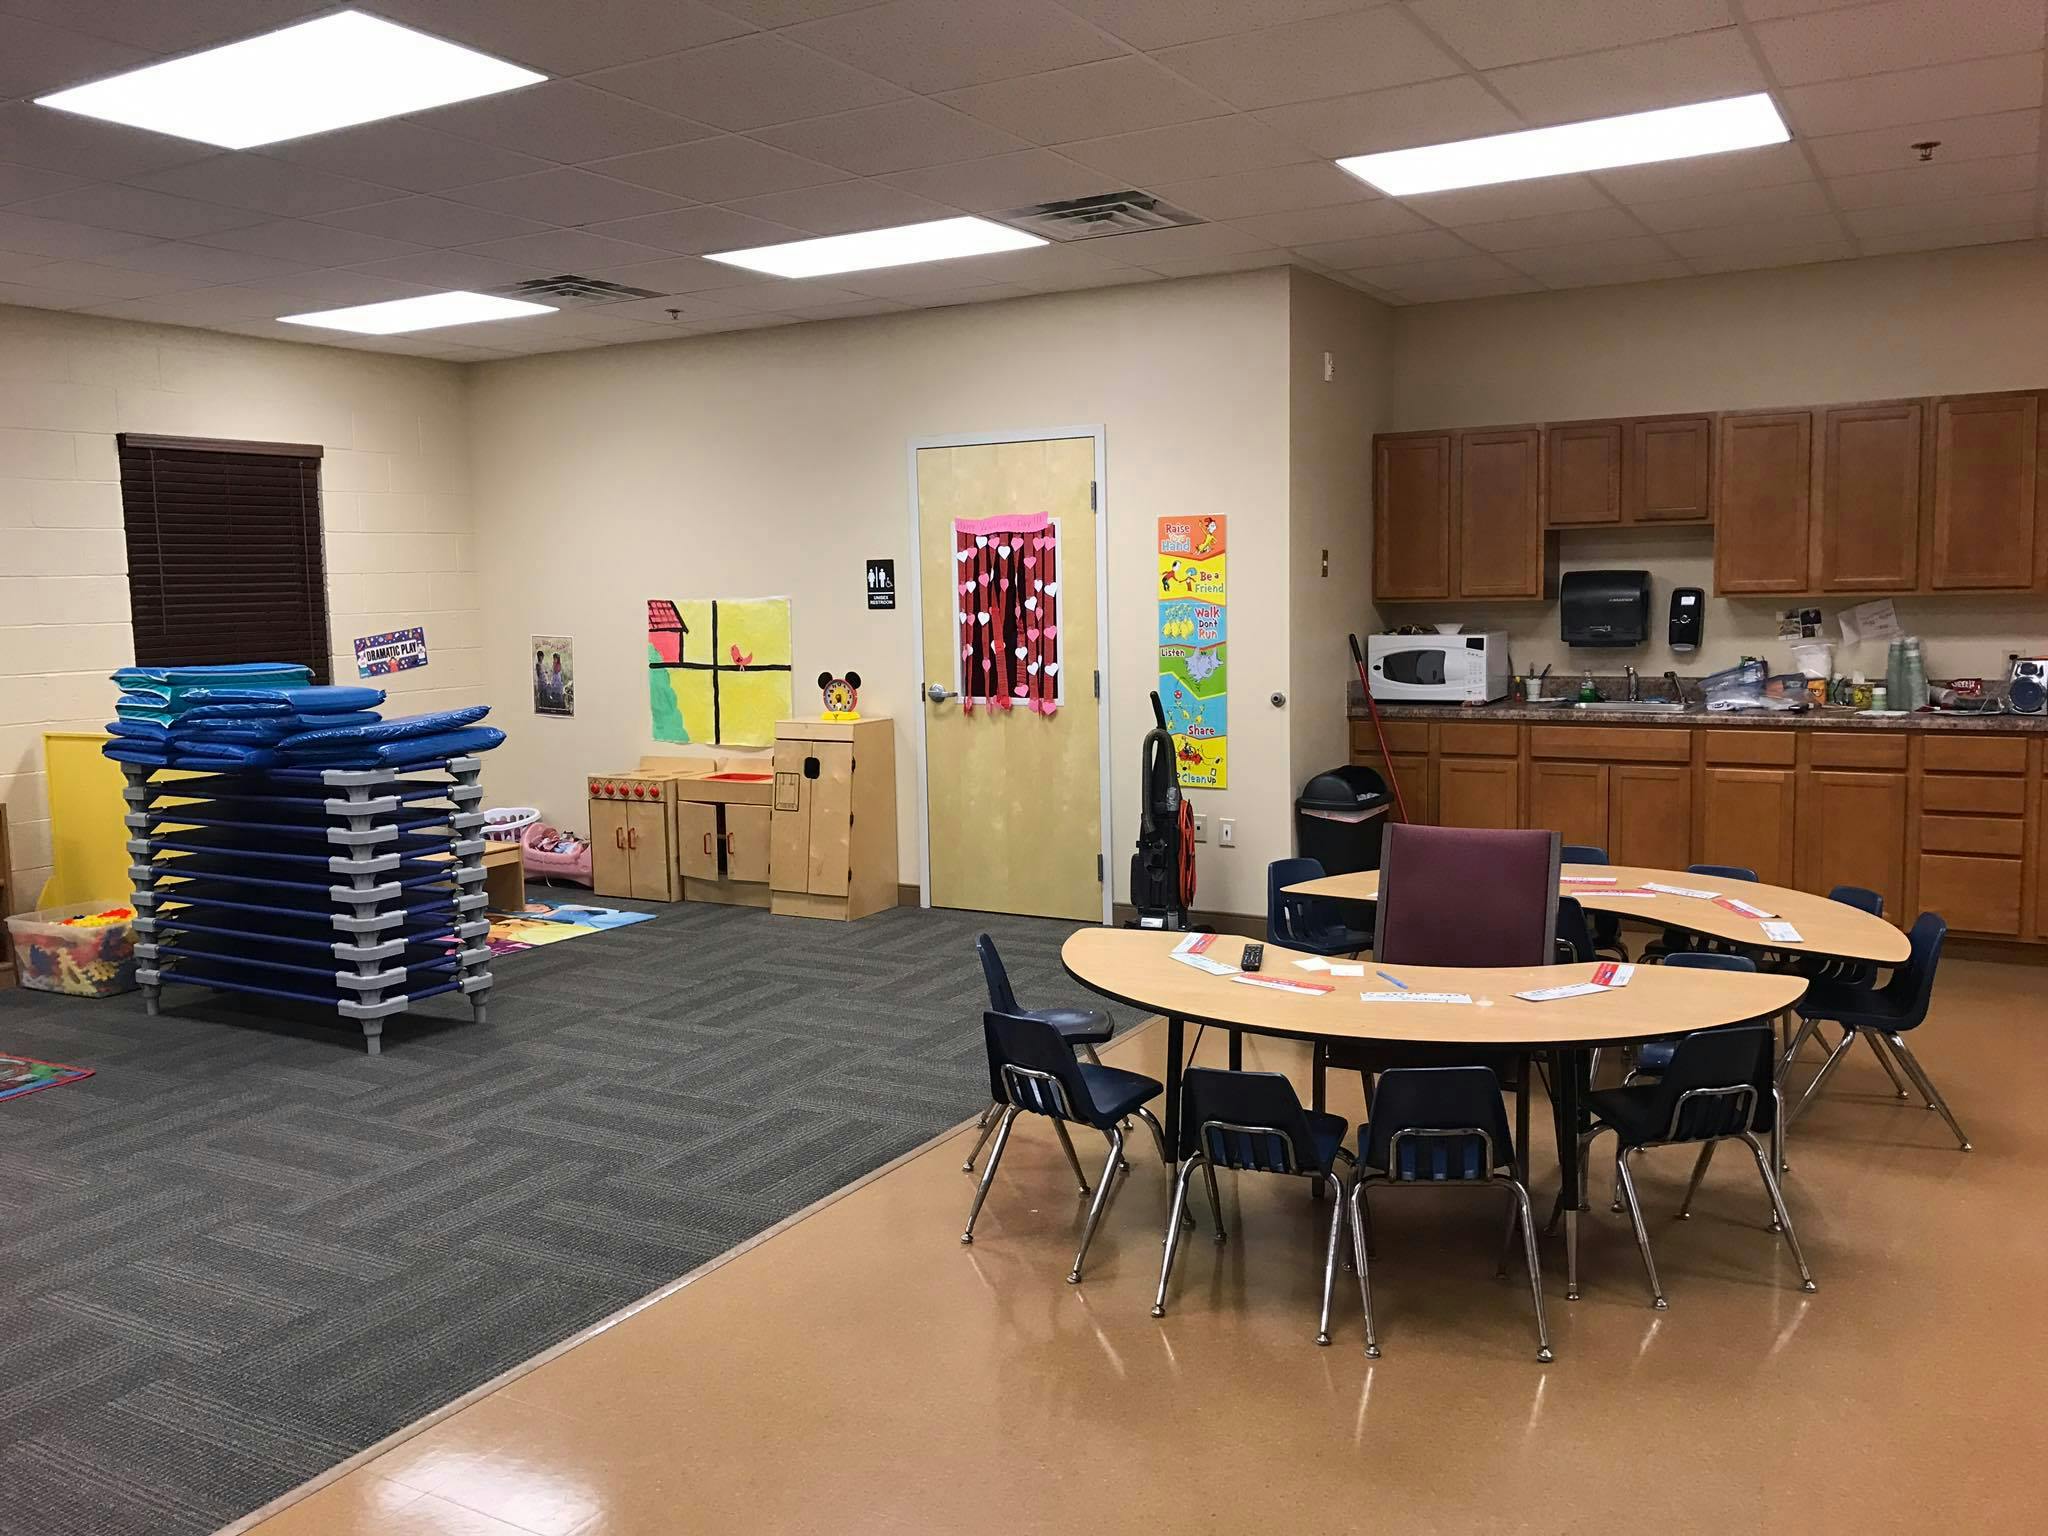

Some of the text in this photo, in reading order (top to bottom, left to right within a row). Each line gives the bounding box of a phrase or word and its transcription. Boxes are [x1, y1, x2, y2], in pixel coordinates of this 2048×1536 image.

[1166, 524, 1189, 533] Raise
[1162, 537, 1190, 551] Hand
[1200, 571, 1212, 581] Be
[1195, 583, 1224, 593] Friend
[1195, 606, 1220, 618] Walk
[1199, 629, 1217, 639] Run
[366, 642, 416, 662] DRAMATIC PLAY
[1161, 648, 1185, 657] Listen
[1188, 725, 1215, 735] Share
